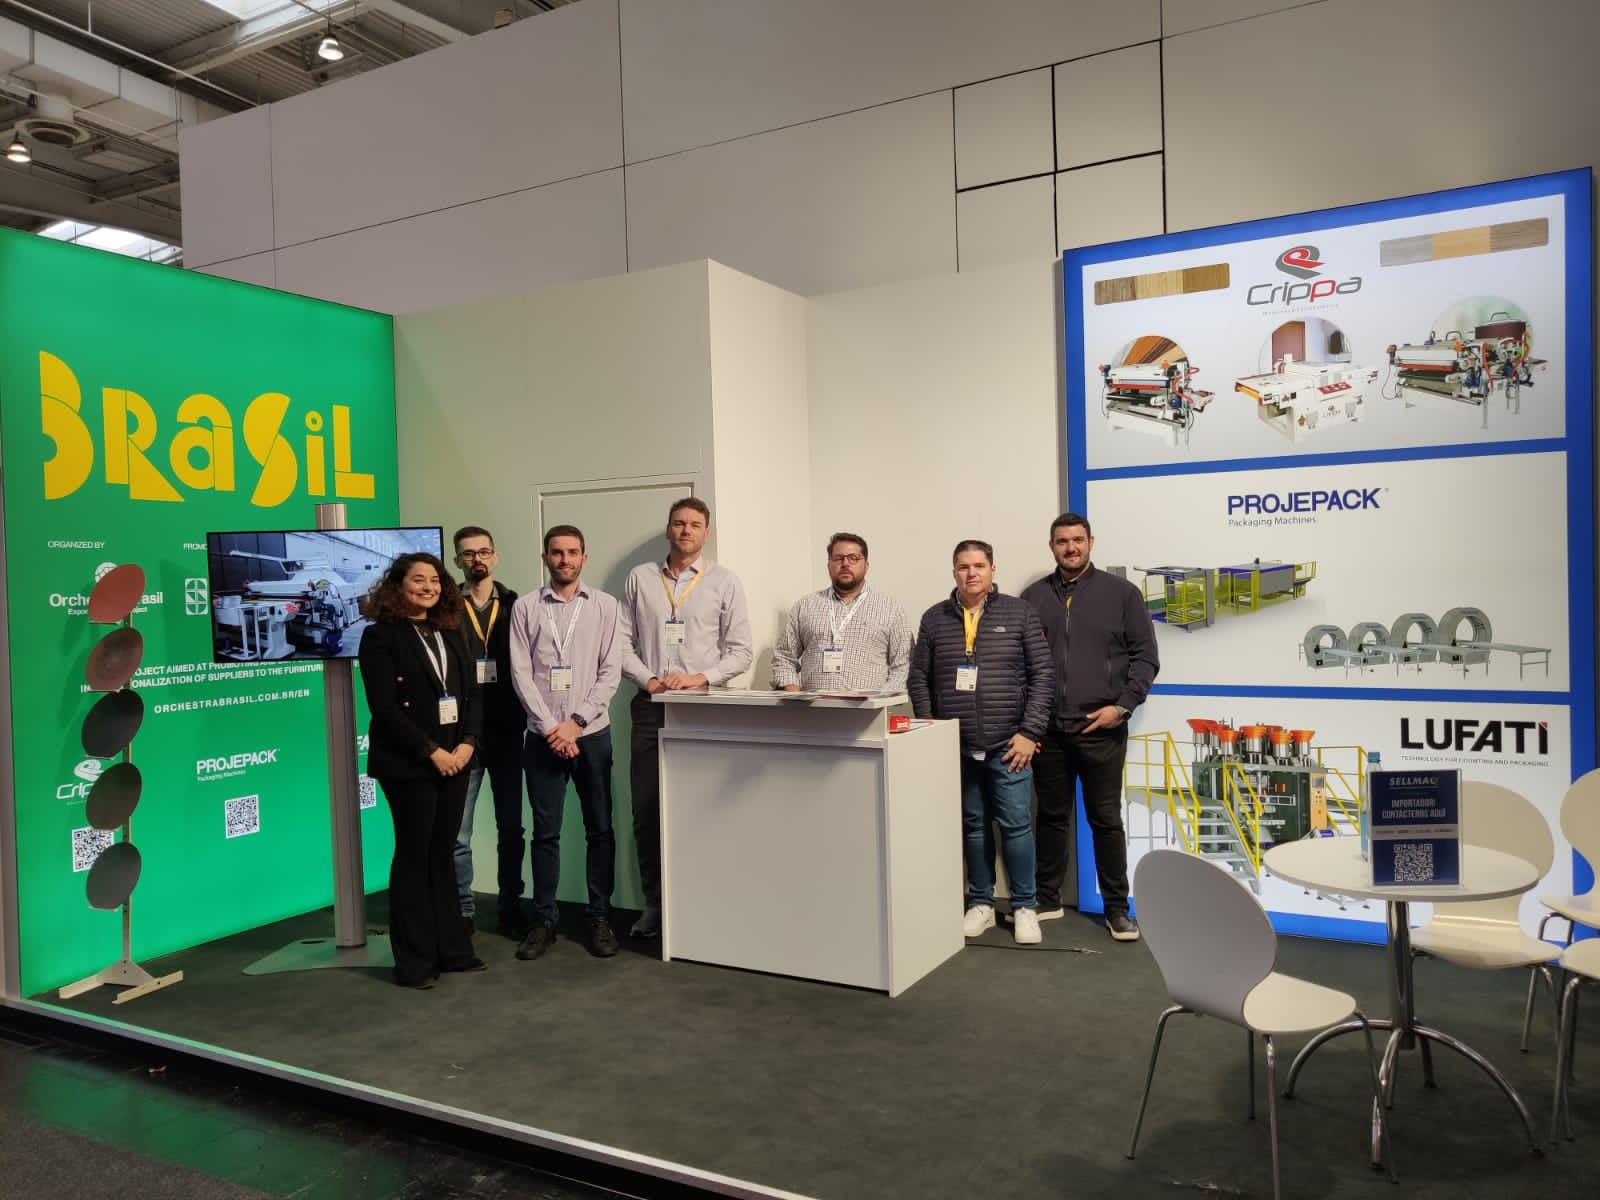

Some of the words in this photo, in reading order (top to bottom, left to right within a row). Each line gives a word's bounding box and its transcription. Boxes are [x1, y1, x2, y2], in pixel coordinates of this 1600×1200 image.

[1227, 487, 1382, 516] PROJEPACK
[1228, 517, 1273, 528] Packaging
[1274, 515, 1317, 525] Machines
[47, 541, 94, 549] ORGANIZED
[94, 541, 105, 549] BY
[183, 543, 208, 551] PROMO
[134, 665, 165, 677] OJECT
[166, 663, 195, 674] AIMED
[196, 662, 207, 671] AT
[194, 673, 206, 683] OF
[207, 669, 254, 681] SUPPLIERS
[256, 668, 266, 677] TO
[268, 667, 283, 676] THE
[154, 688, 310, 714] ORCHESTRABRASIL.COM.BR/EN
[1400, 717, 1549, 755] LUFATI
[196, 748, 277, 775] PROJEPACK
